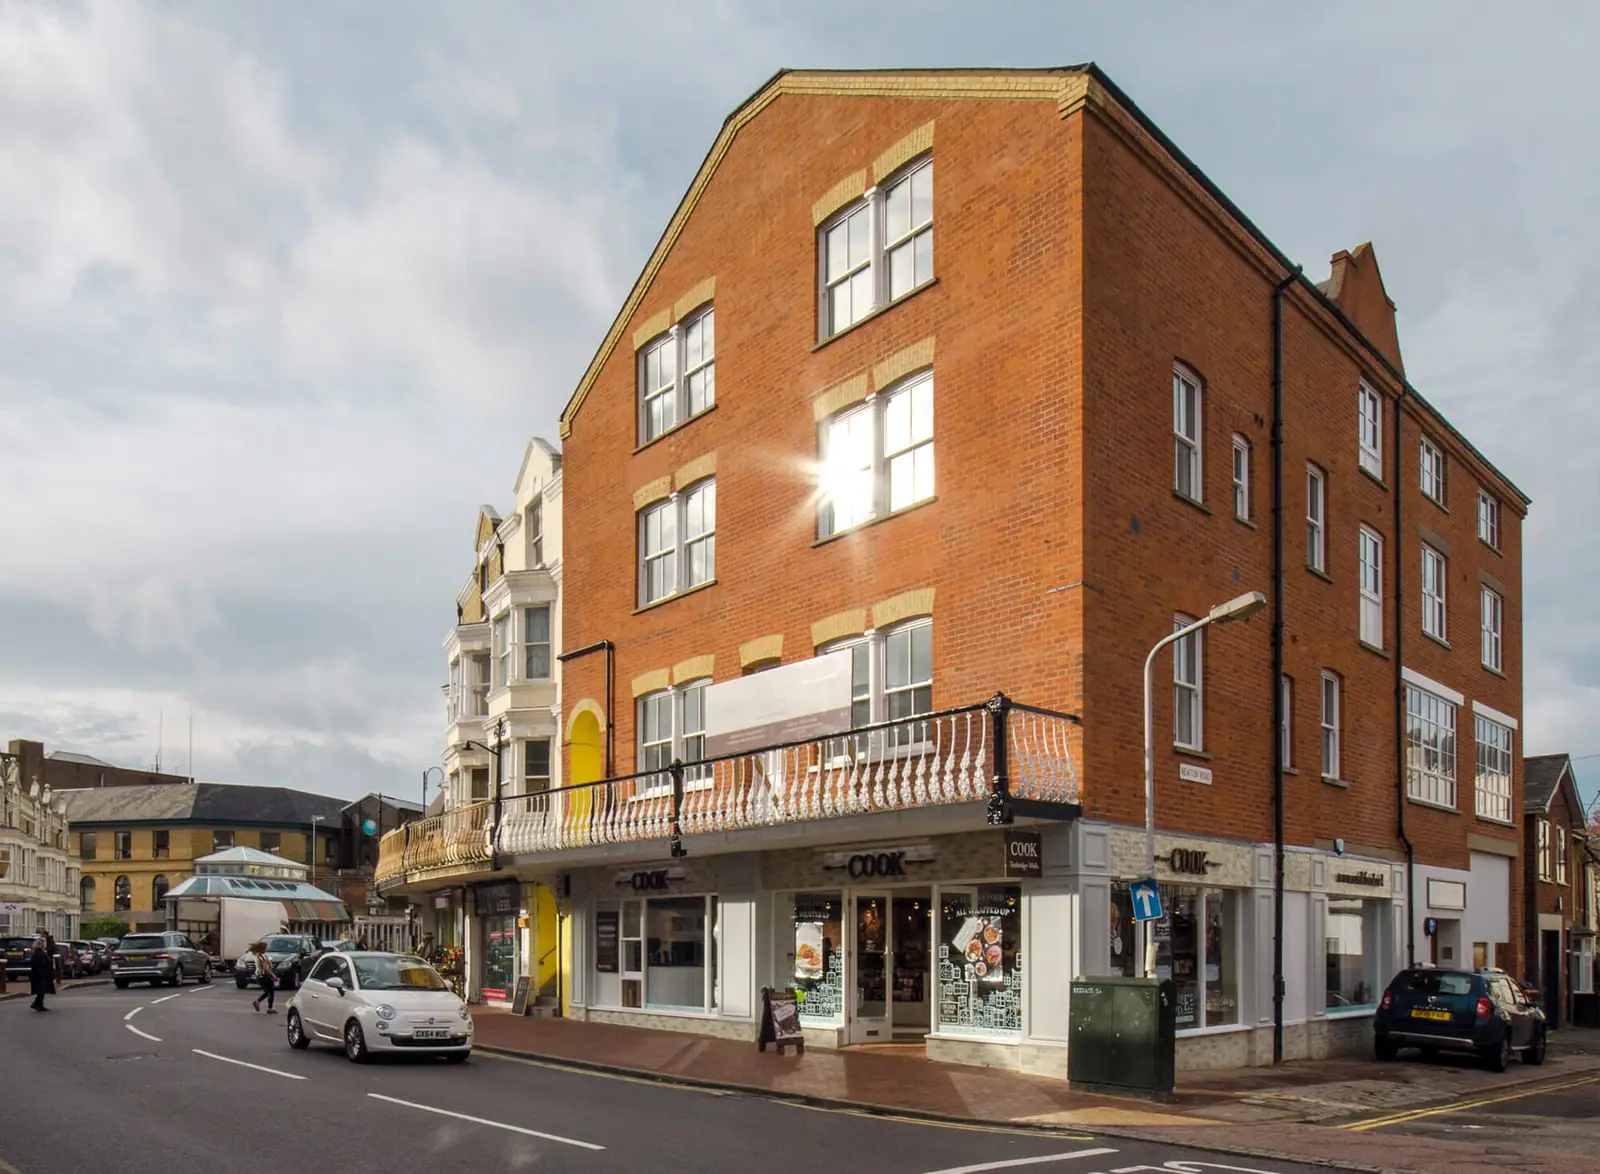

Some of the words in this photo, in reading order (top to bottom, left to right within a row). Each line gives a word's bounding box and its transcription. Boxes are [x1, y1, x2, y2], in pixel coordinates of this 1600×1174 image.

[1010, 841, 1038, 857] COOK
[847, 852, 905, 878] COOK
[1171, 848, 1208, 875] COOK
[631, 870, 668, 891] COOK
